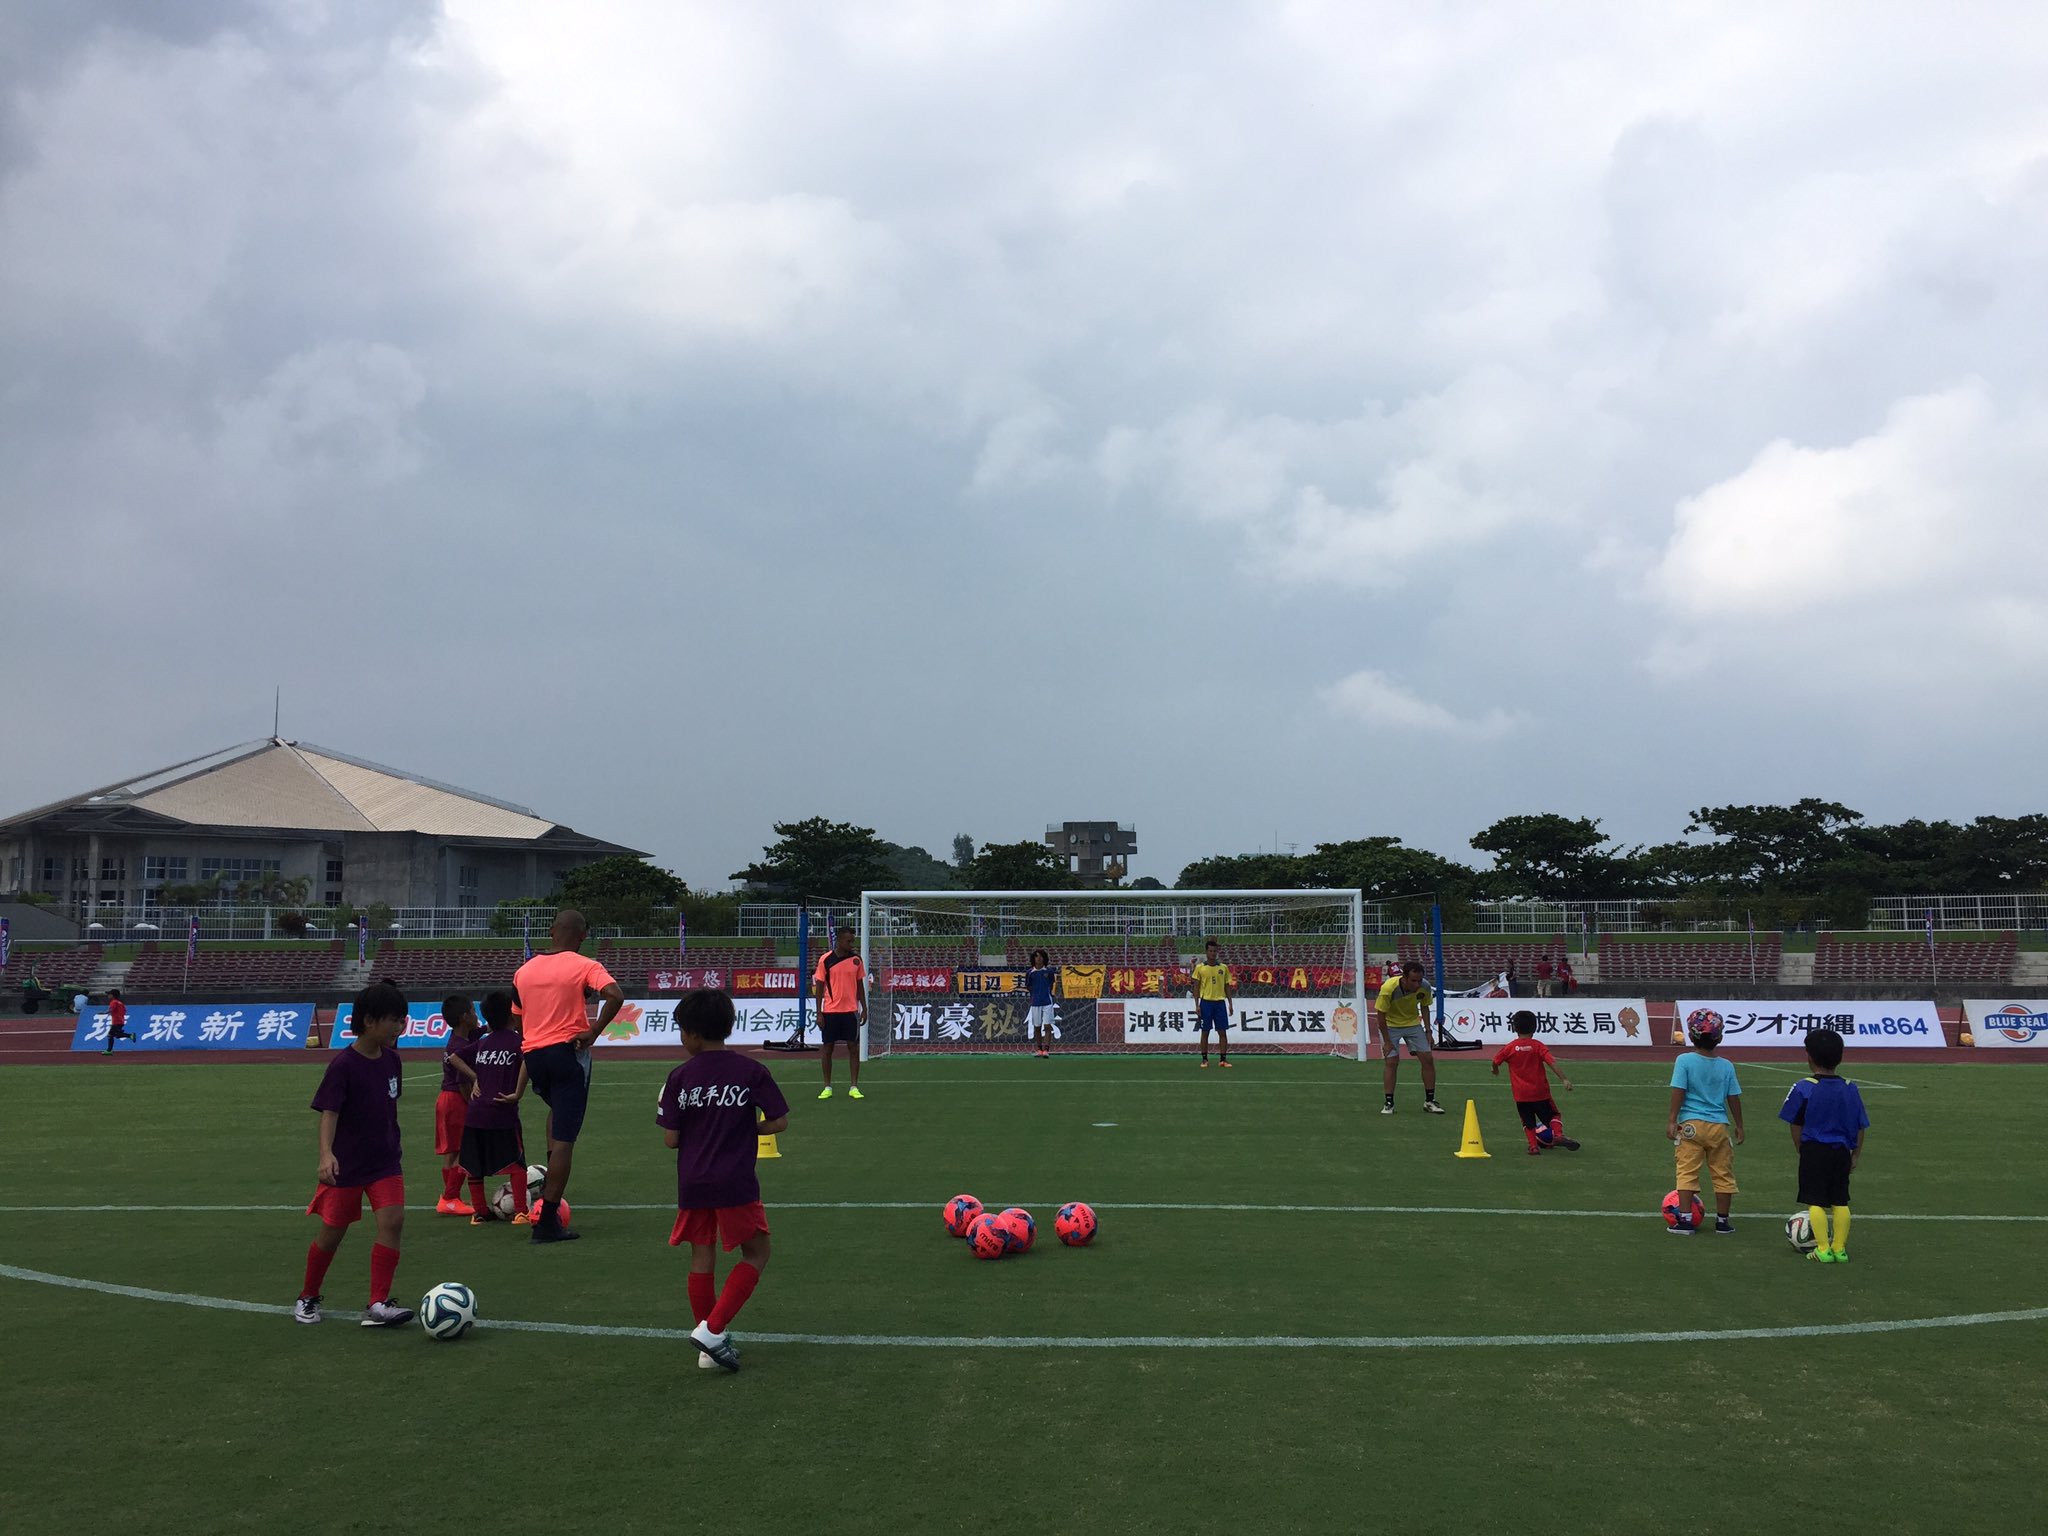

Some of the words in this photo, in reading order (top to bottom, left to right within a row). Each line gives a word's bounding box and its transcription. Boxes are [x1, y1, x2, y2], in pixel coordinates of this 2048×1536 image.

[655, 971, 692, 989] 富所
[703, 970, 721, 987] 悠
[1988, 1017, 2017, 1027] BLUE
[2019, 1017, 2047, 1028] SEAL
[979, 1232, 999, 1251] mitre
